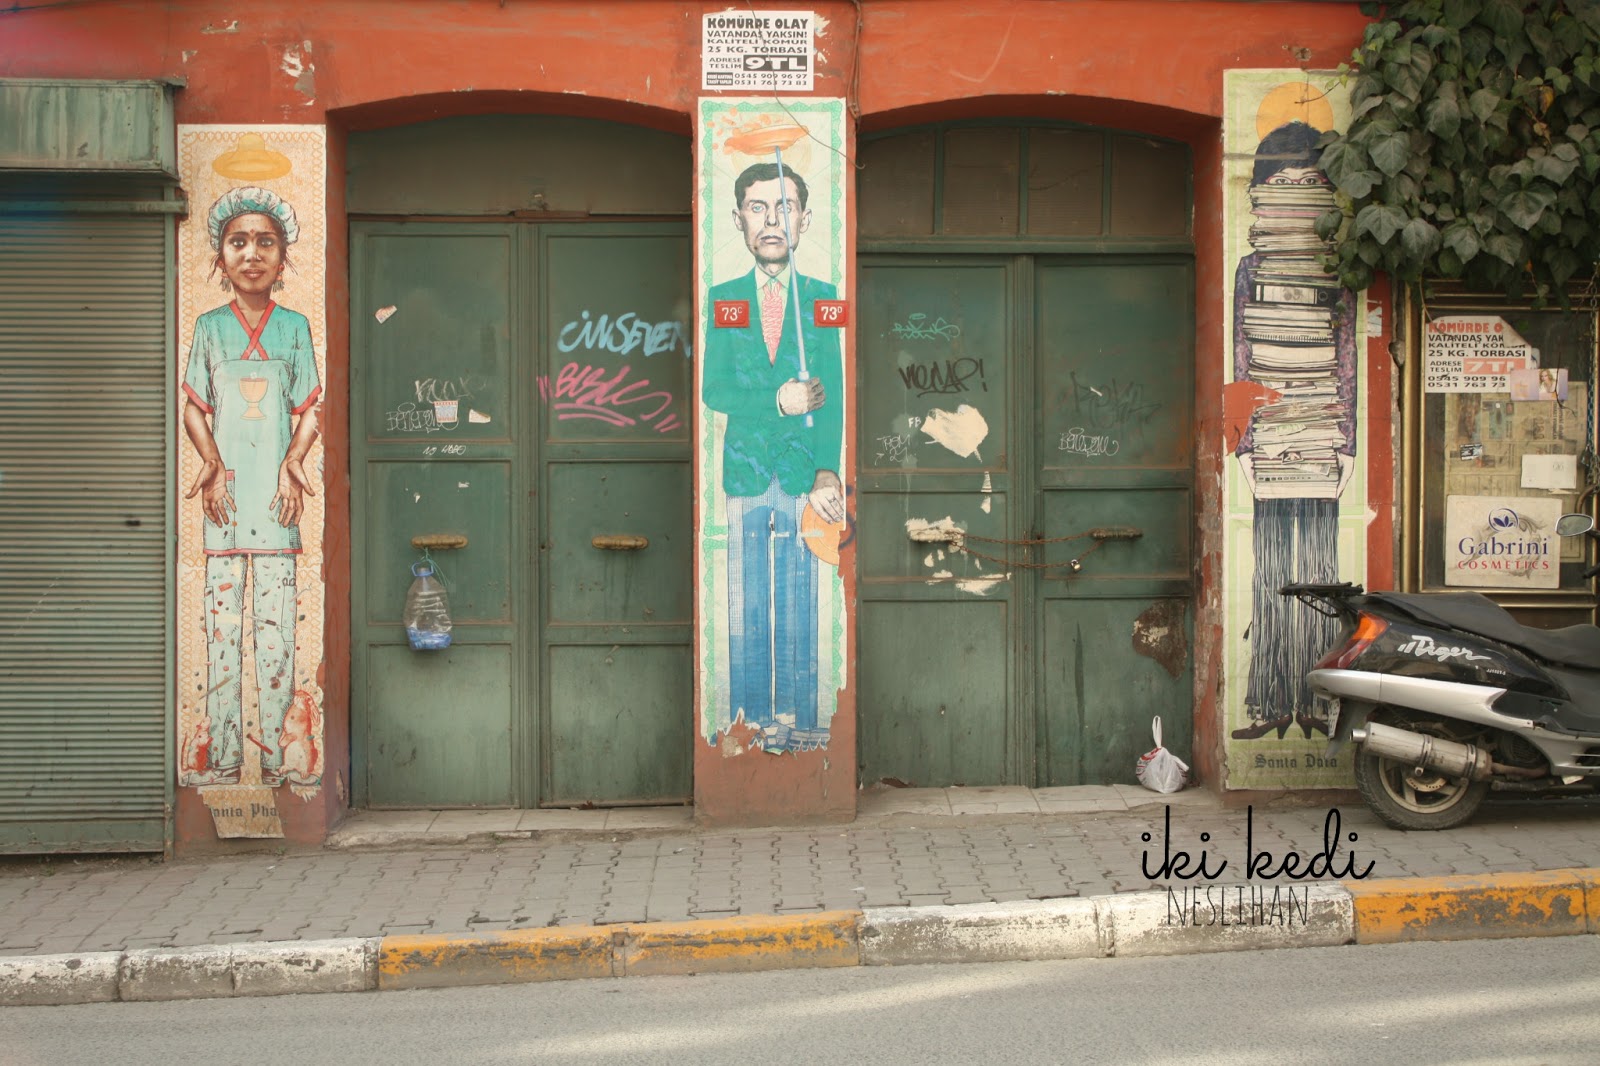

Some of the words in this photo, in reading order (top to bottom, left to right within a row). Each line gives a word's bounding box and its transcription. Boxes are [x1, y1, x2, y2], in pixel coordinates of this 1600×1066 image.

[707, 15, 770, 29] KÖMÜRDE
[775, 18, 809, 29] OLAY
[726, 46, 748, 54] KG.
[745, 56, 807, 70] 9TL
[1428, 320, 1490, 333] KÖMÜRDE
[1458, 537, 1549, 556] Gabrini
[1458, 560, 1549, 570] COSMETICS
[1409, 634, 1492, 662] Tiger
[1254, 753, 1297, 768] Santa
